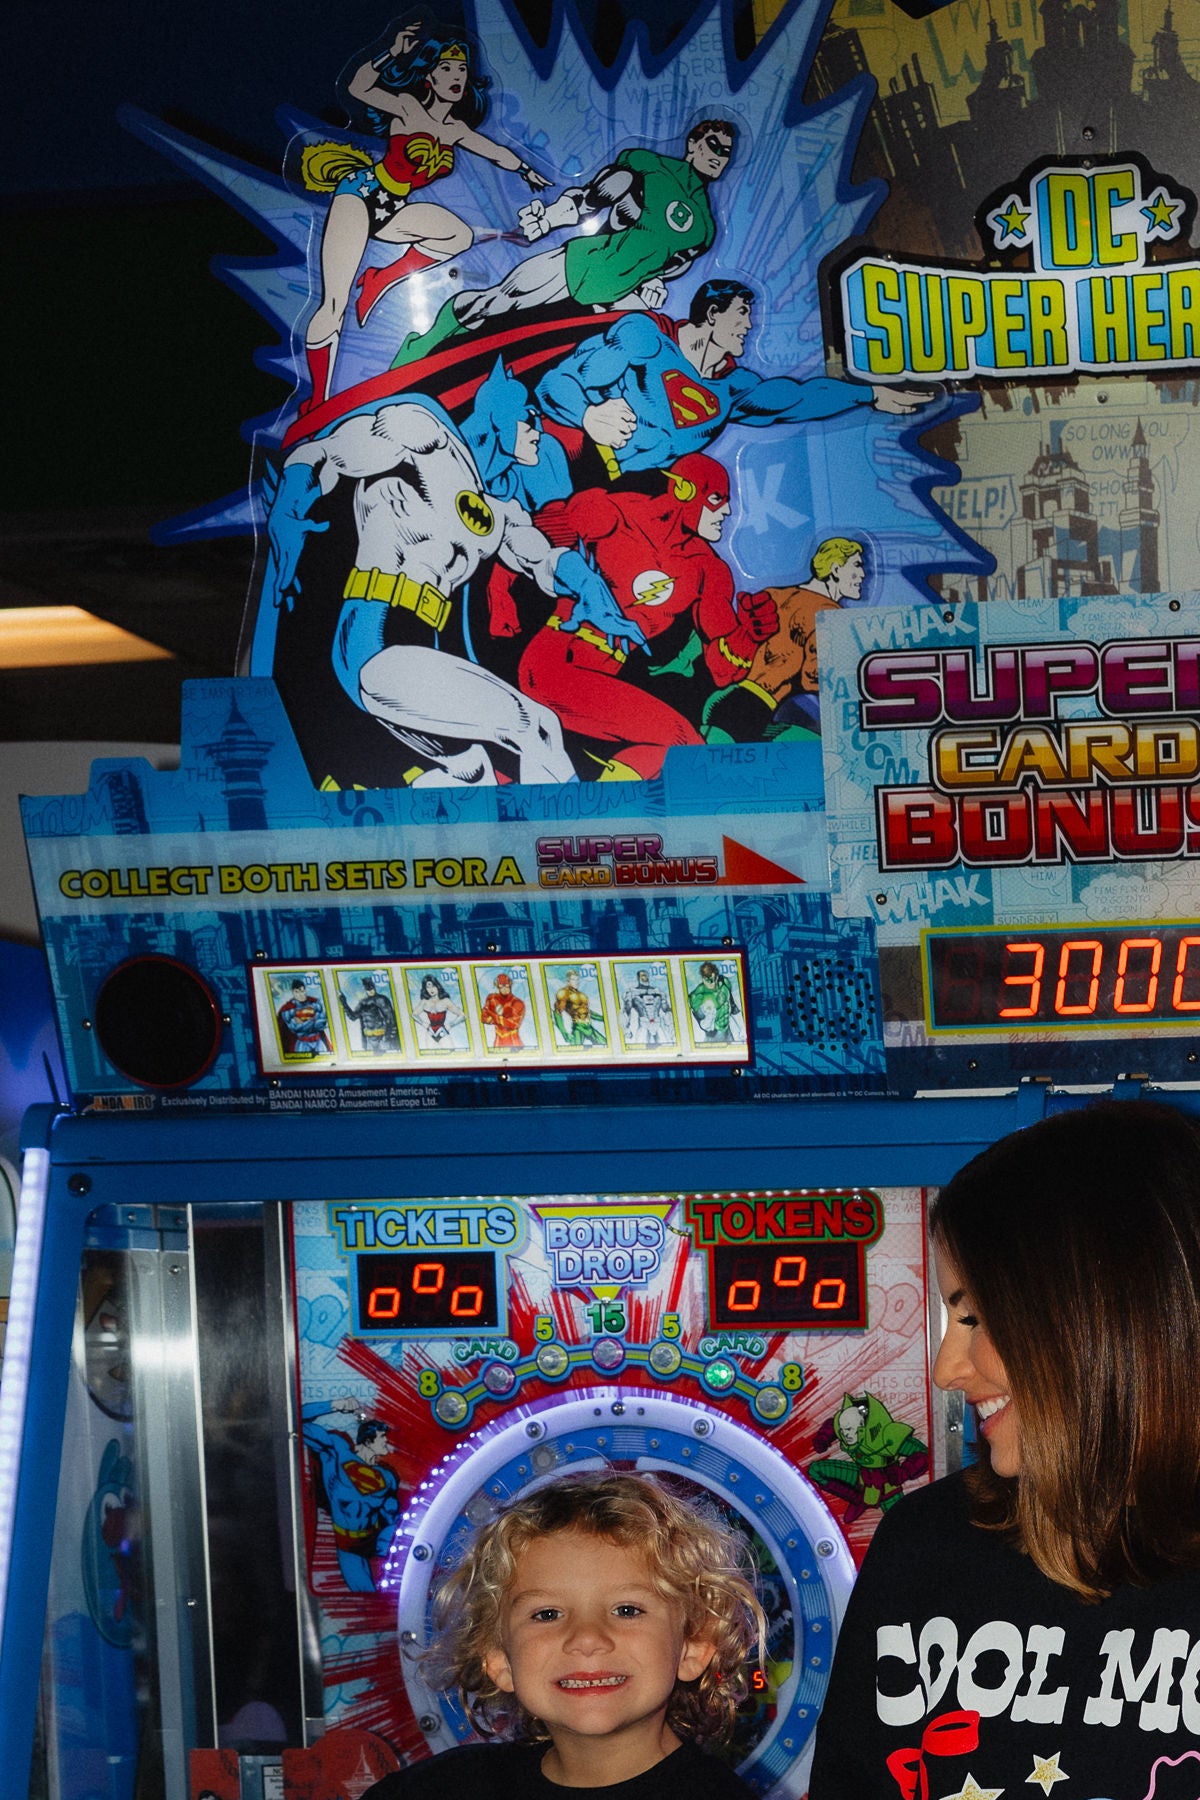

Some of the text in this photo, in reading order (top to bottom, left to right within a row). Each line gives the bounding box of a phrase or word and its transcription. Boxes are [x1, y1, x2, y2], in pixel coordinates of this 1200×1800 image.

[1037, 169, 1139, 270] DC
[848, 262, 1068, 375] SUPER
[854, 606, 978, 652] WHAK
[535, 832, 664, 865] SUPER
[58, 855, 526, 899] COLLECT BOTH SETS FOR A
[538, 855, 718, 889] CARD BONUS
[866, 875, 992, 926] WHAK
[269, 1089, 302, 1100] BANDAI
[302, 1088, 336, 1099] NAMCO
[337, 1087, 388, 1099] Amusement
[388, 1086, 424, 1098] America
[270, 1099, 303, 1110] BANDAI
[303, 1099, 337, 1109] NAMCO
[338, 1098, 389, 1109] Amusement
[390, 1097, 421, 1110] Europe
[336, 1205, 518, 1249] TICKETS
[547, 1216, 664, 1251] BONUS
[693, 1199, 876, 1242] TOKENS
[558, 1248, 659, 1283] DROP
[535, 1315, 556, 1342] 5
[587, 1302, 626, 1335] 15
[661, 1313, 682, 1340] 5
[451, 1339, 519, 1365] CARD
[700, 1332, 768, 1358] CARD
[418, 1369, 441, 1398] 8
[781, 1363, 805, 1393] 8
[875, 1616, 1070, 1728] COOL
